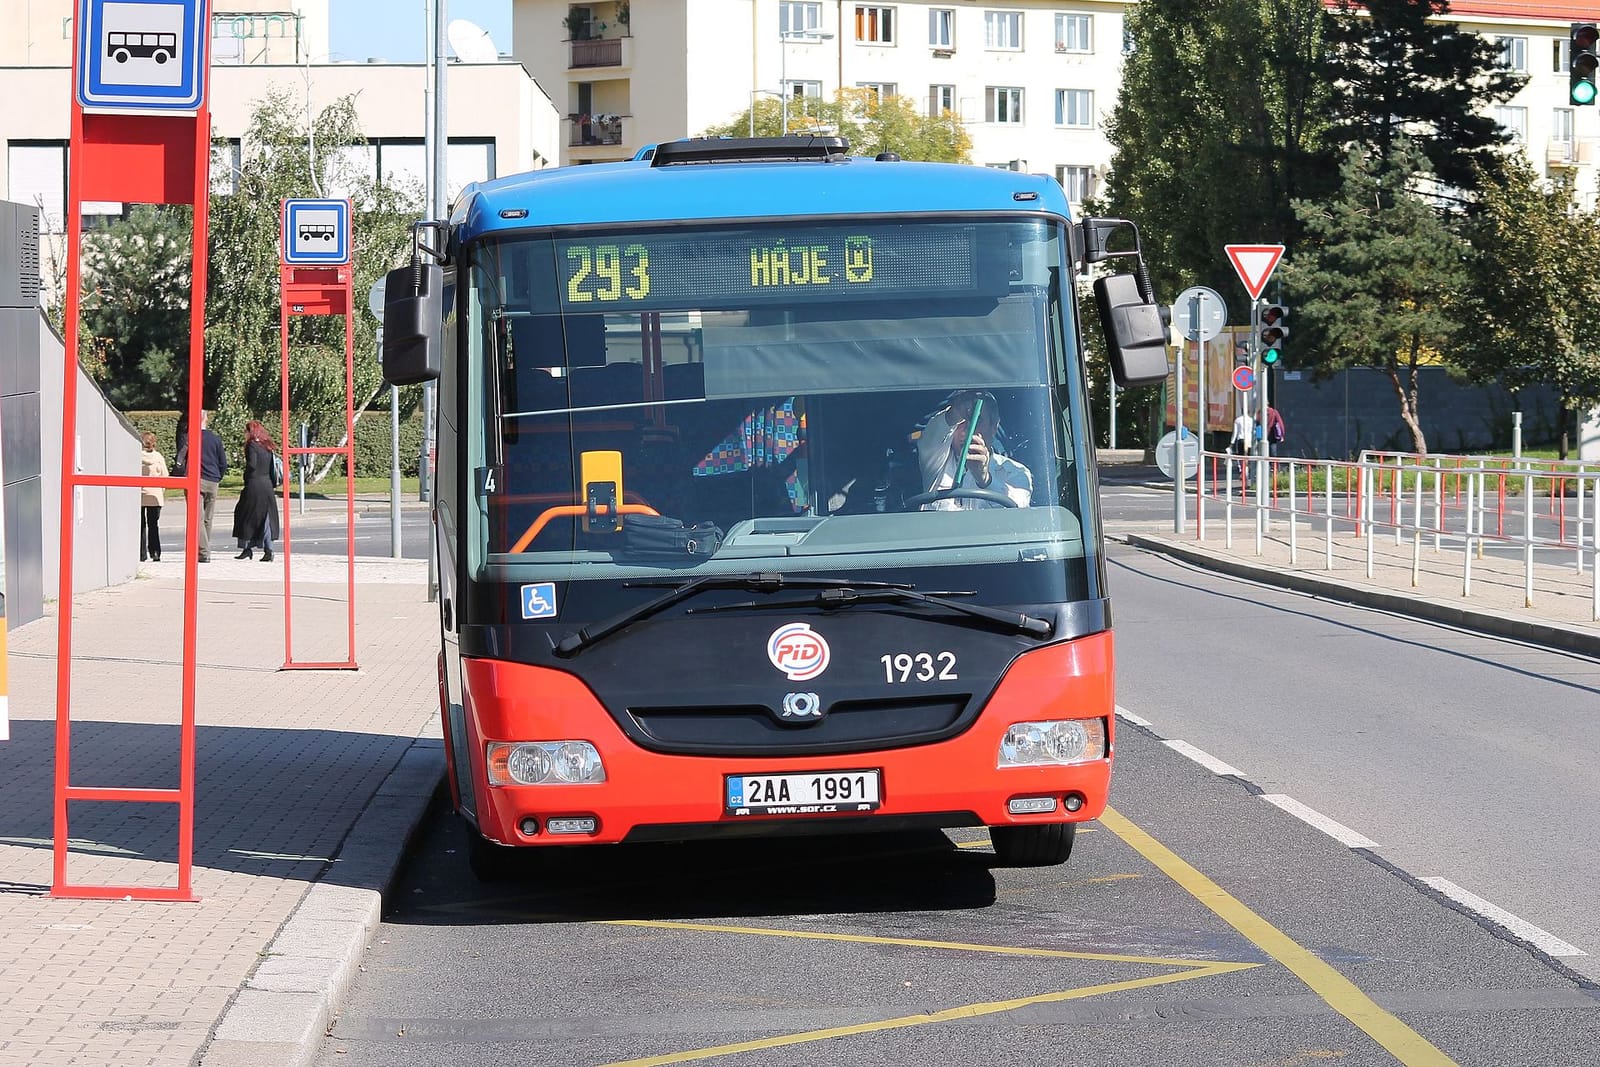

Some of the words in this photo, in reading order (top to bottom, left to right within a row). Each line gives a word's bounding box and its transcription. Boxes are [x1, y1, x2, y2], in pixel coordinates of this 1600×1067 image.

[567, 244, 650, 302] 293
[751, 238, 831, 286] HÁJE
[485, 469, 496, 493] 4
[880, 651, 959, 684] 1932
[731, 796, 743, 804] CZ
[749, 779, 791, 803] 2AA
[811, 776, 865, 801] 1991
[766, 804, 837, 814] www.sor.cz
